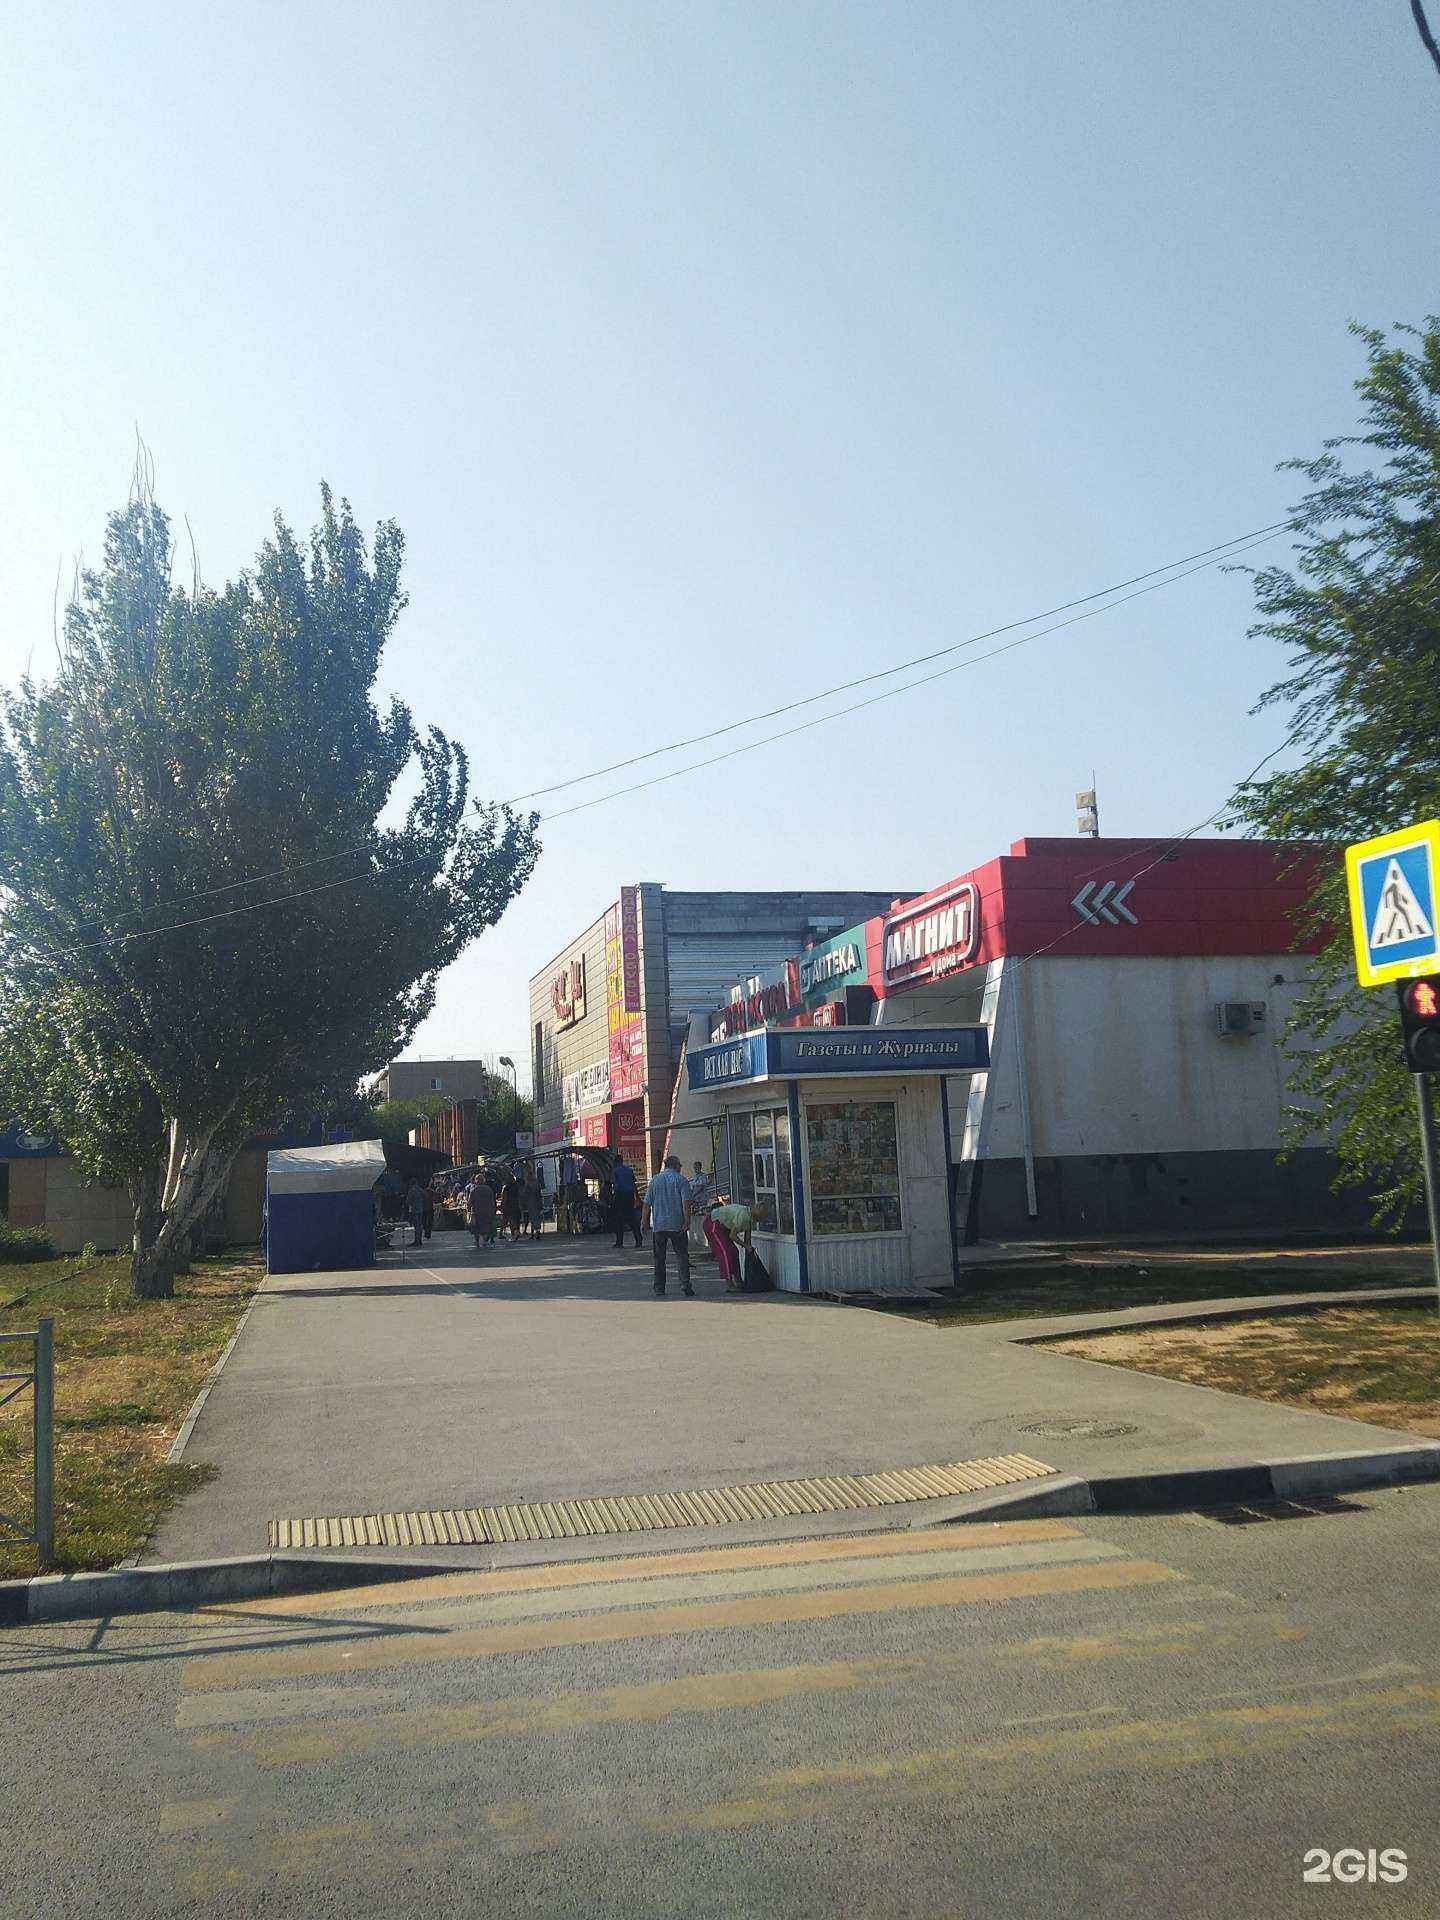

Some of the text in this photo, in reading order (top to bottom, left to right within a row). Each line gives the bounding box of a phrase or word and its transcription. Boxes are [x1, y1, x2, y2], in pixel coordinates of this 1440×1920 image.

[885, 900, 970, 971] МАГНИТ
[812, 943, 861, 984] АПТЕКА
[797, 1039, 960, 1058] Газеты и Журналы
